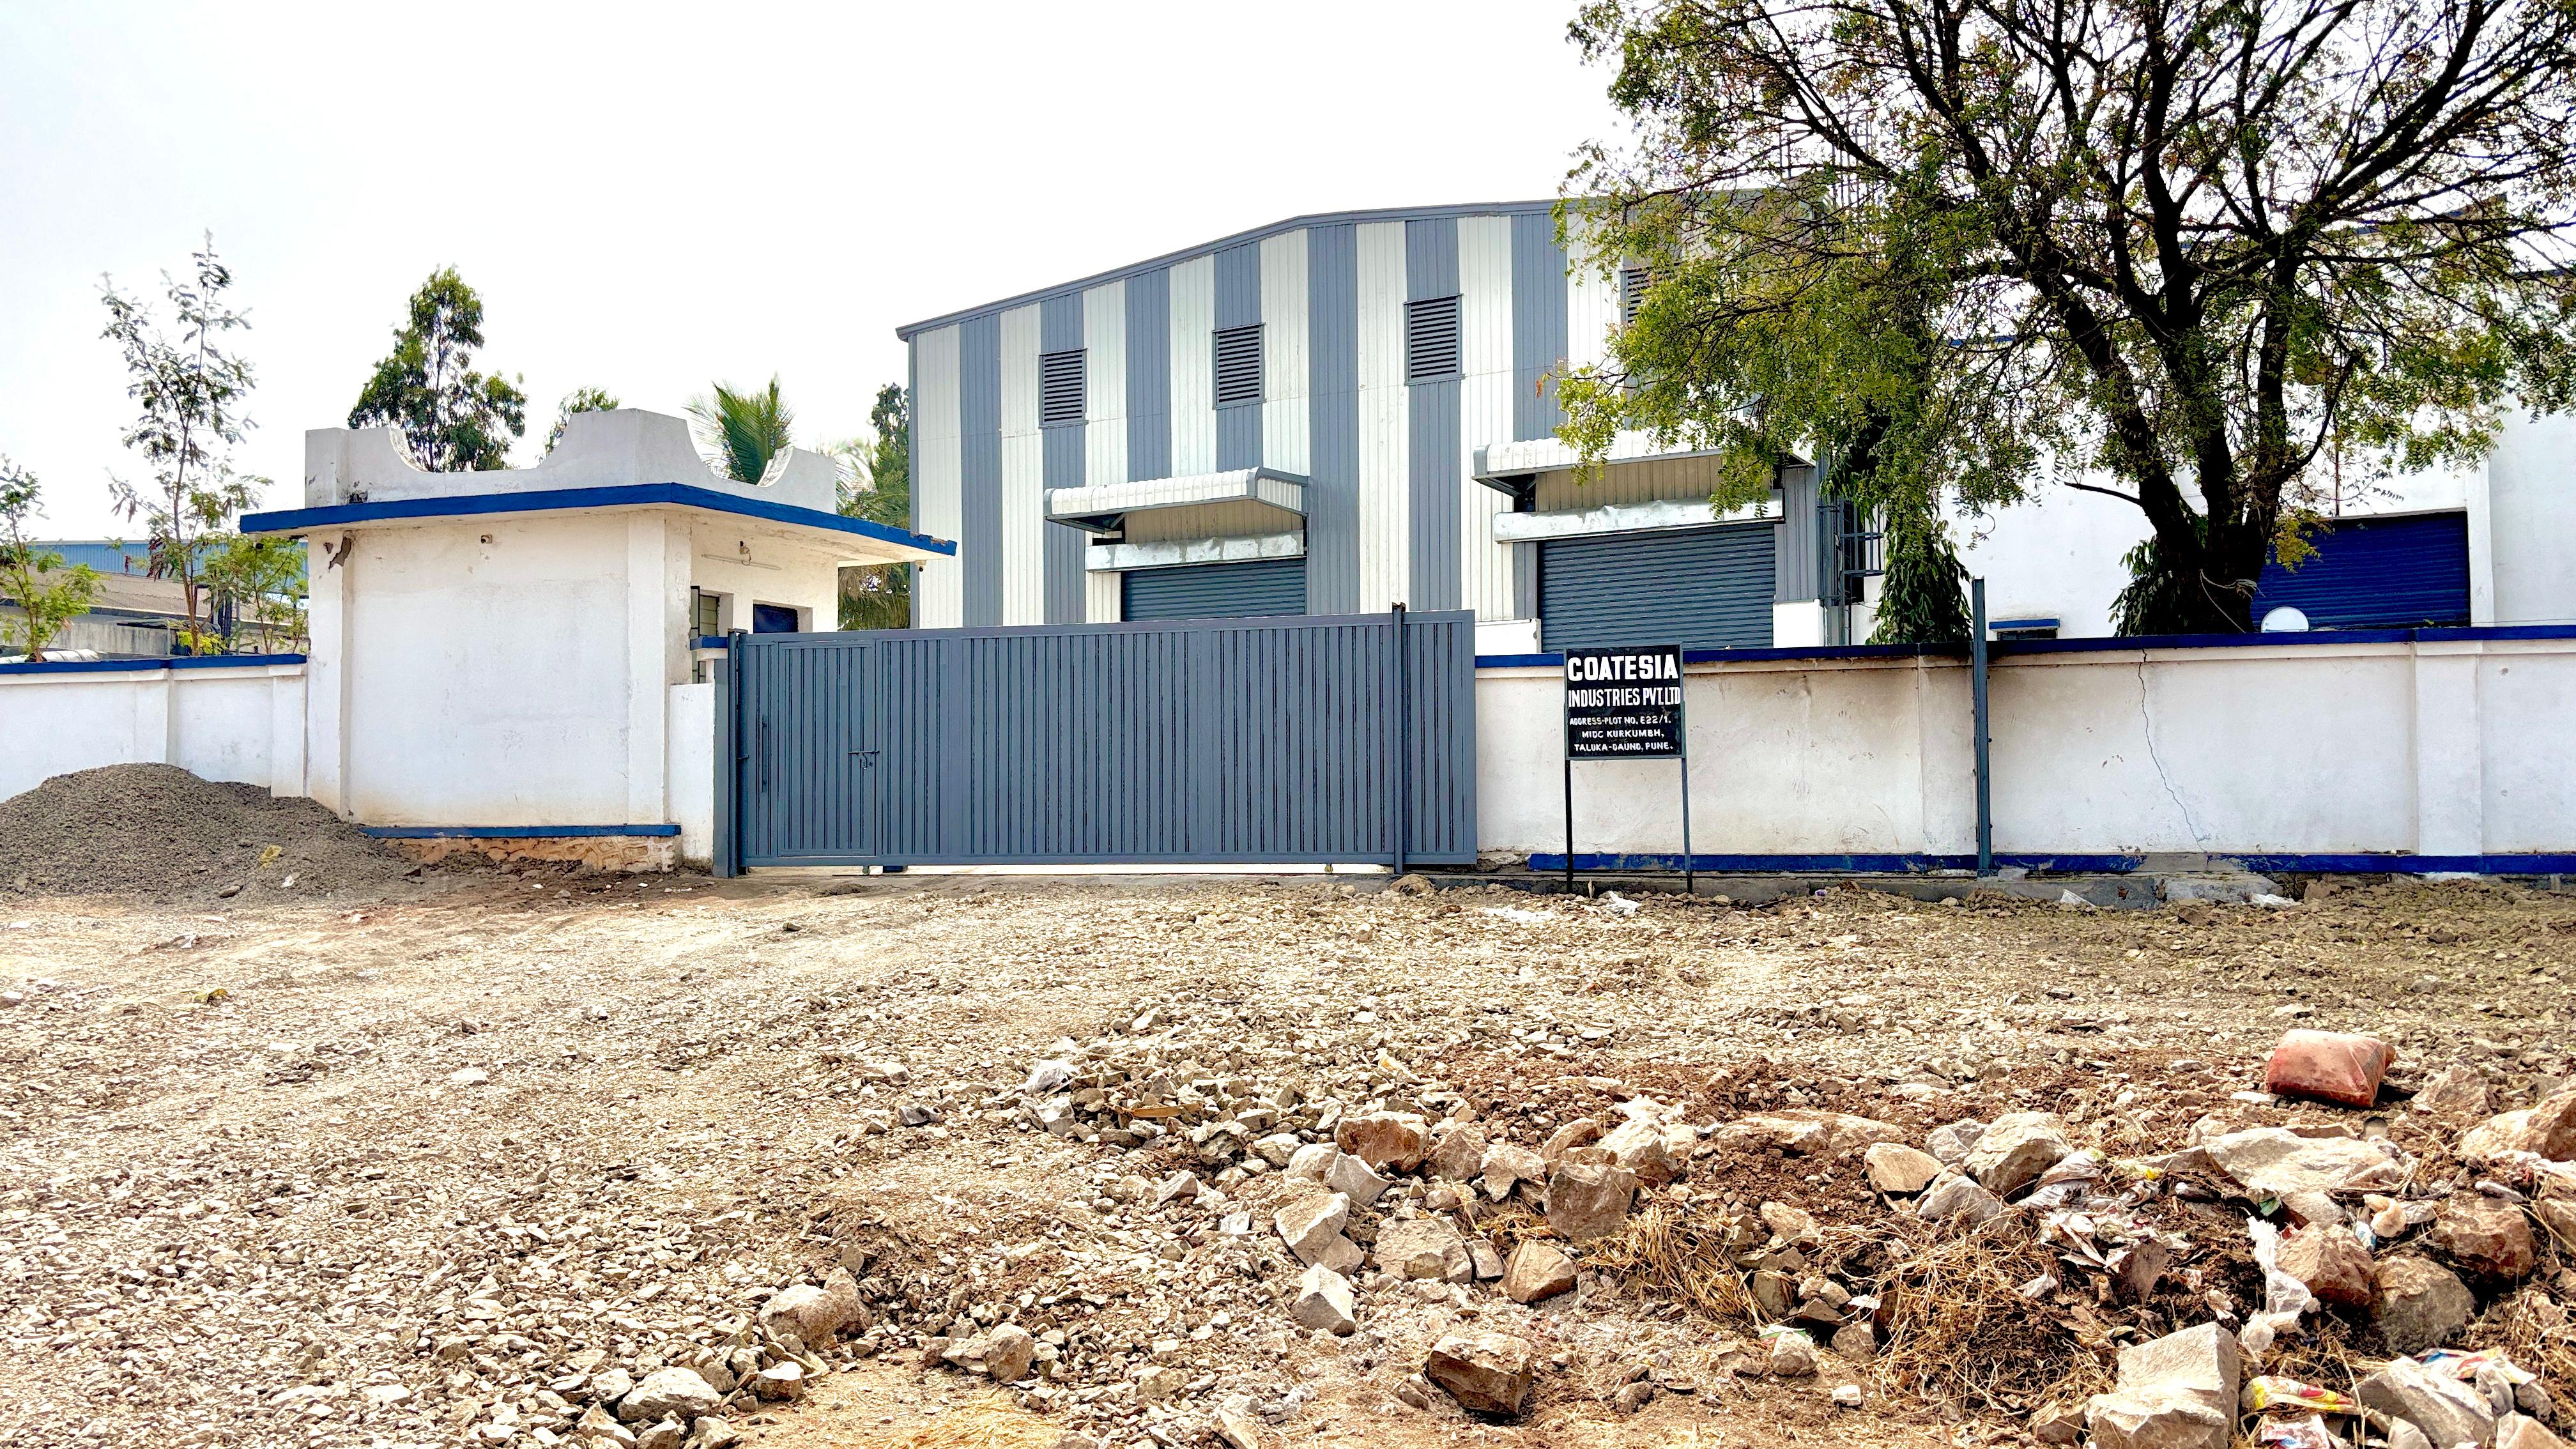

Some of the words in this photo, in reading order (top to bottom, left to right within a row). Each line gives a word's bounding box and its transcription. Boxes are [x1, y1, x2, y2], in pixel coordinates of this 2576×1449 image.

[1567, 654, 1678, 681] COATESIA
[1568, 688, 1639, 707] INDUSTRIES
[1640, 714, 1671, 724] E22/1.
[1607, 729, 1664, 738] KURKUMBH,
